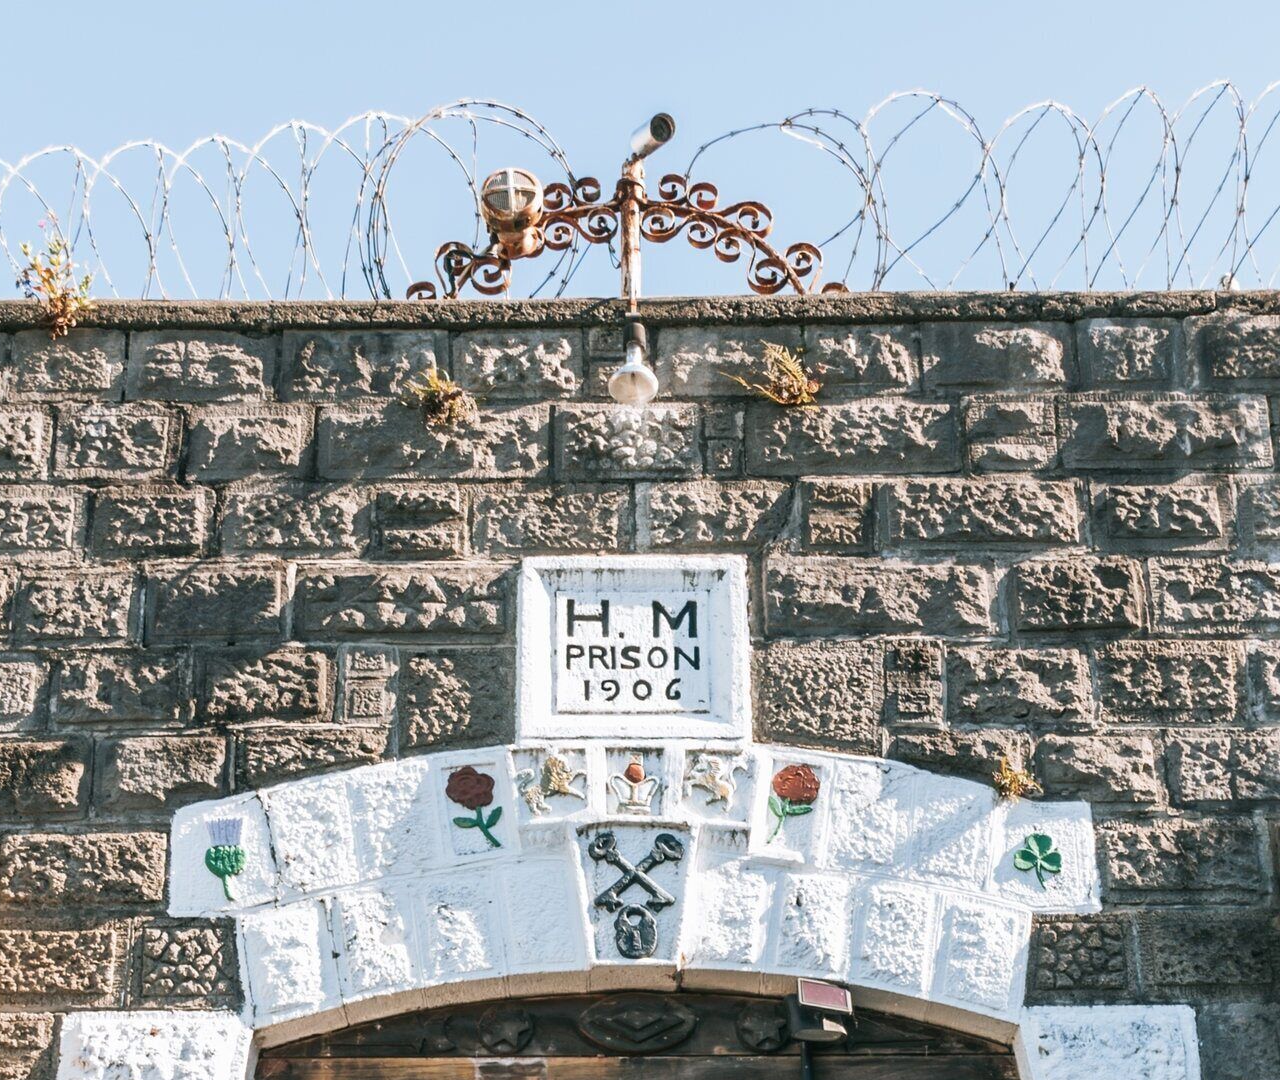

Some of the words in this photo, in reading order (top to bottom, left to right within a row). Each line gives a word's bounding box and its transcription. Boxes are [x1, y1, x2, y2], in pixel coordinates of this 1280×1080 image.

[567, 599, 624, 639] H.
[652, 599, 697, 638] M
[566, 644, 700, 670] PRISON
[584, 677, 681, 701] 1906
